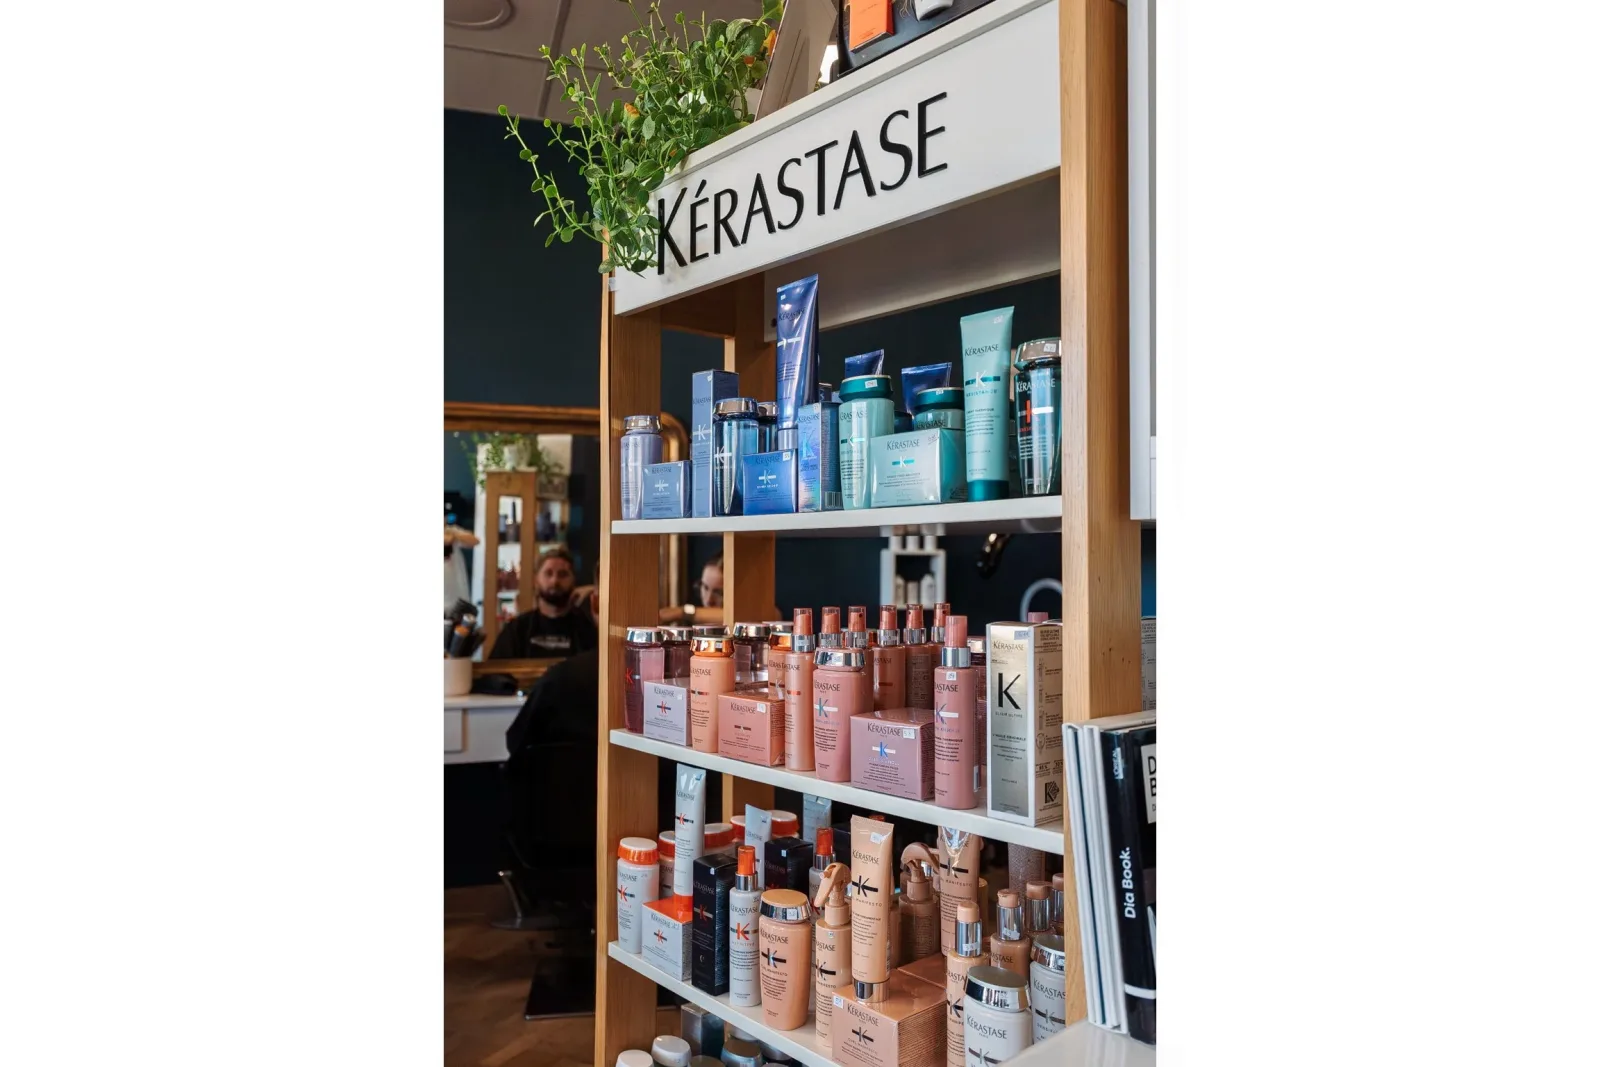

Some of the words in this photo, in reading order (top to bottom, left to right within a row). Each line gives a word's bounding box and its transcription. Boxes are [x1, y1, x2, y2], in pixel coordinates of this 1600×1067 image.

[657, 91, 948, 276] KÉRASTASE
[964, 343, 999, 357] KÉRASTASE
[886, 438, 920, 451] KÉRASTASE
[992, 640, 1024, 651] KÉRASTASE
[998, 672, 1021, 710] K
[730, 702, 756, 714] KÉRASTASE
[867, 722, 901, 736] KÉRASTASE
[852, 849, 880, 864] KÉRASTASE
[1119, 846, 1134, 889] Book.
[1123, 892, 1137, 919] Dia
[760, 927, 789, 944] KÉRASTASE
[847, 1003, 880, 1026] KÉRASTASE
[966, 1014, 1007, 1039] KÉRASTASE
